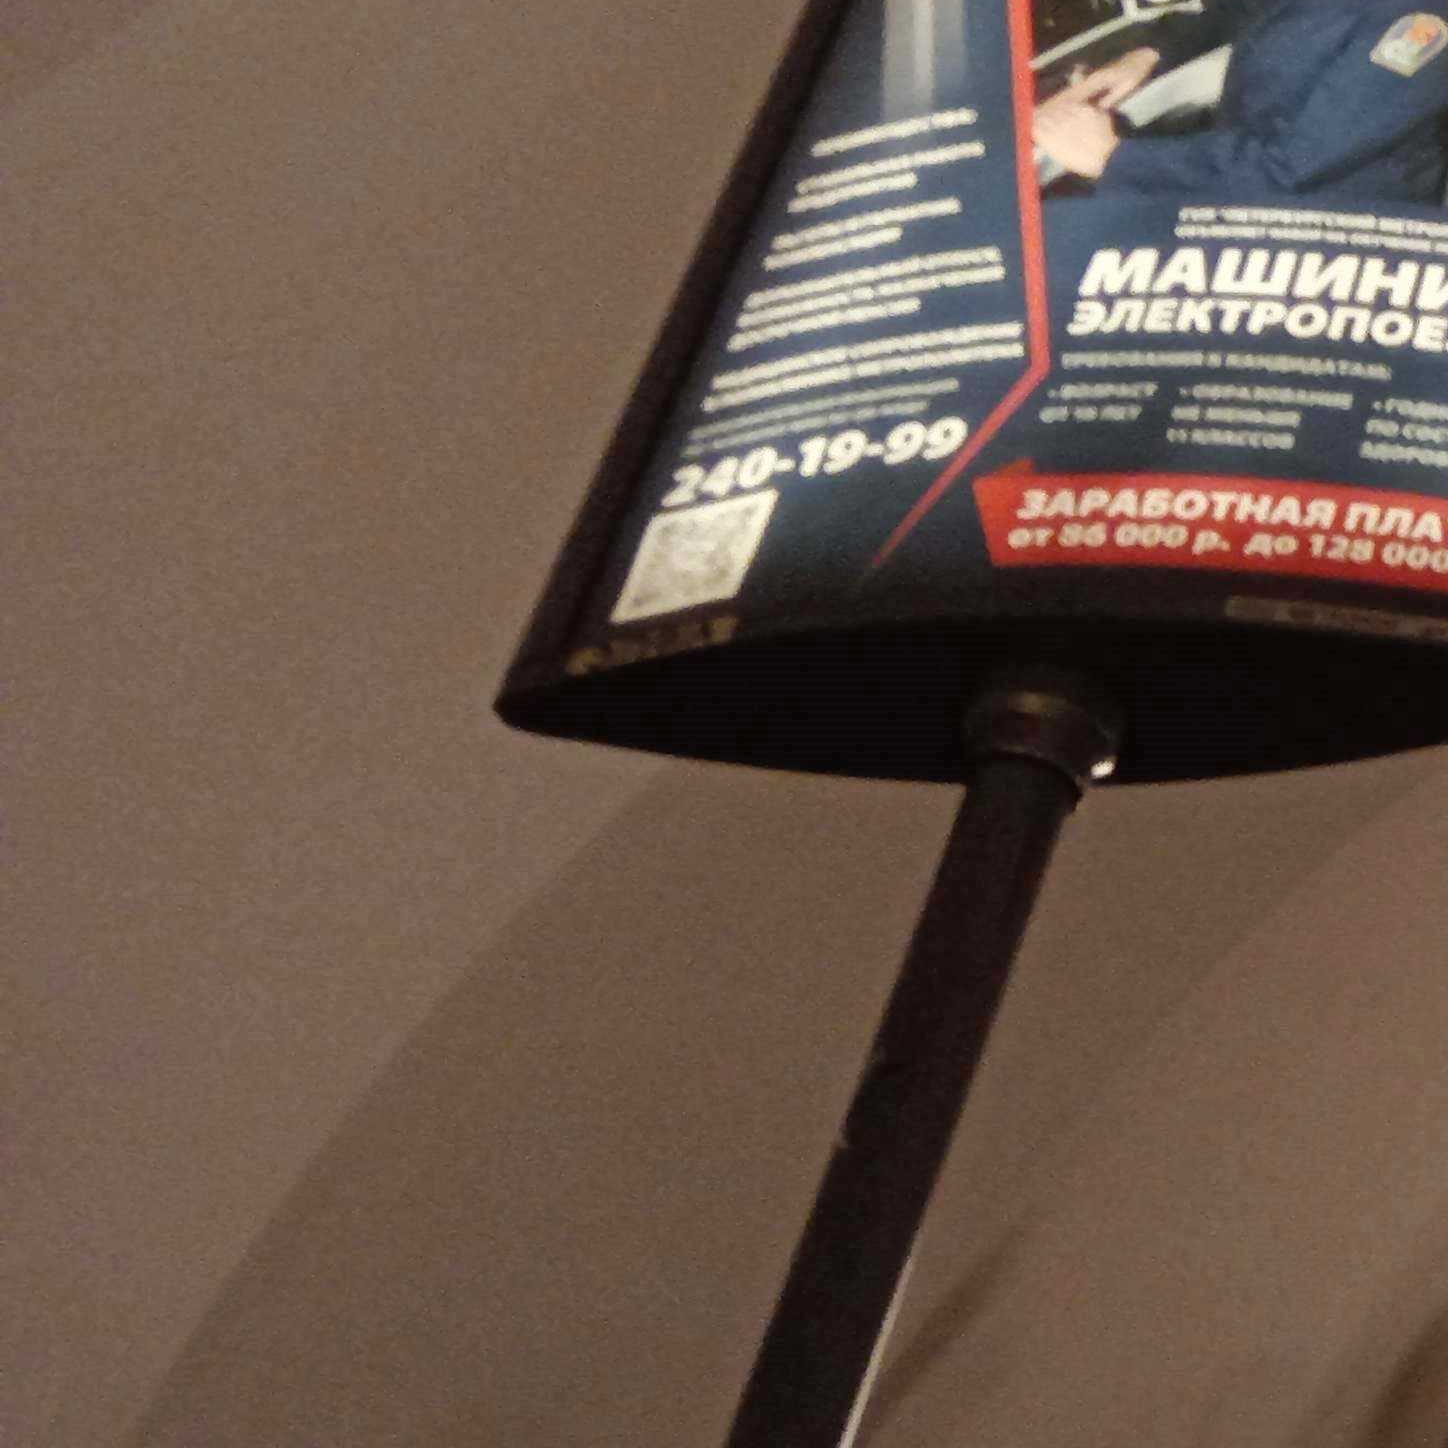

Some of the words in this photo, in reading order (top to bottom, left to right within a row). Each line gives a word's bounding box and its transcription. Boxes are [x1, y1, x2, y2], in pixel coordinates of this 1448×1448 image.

[661, 415, 968, 508] 240-19-99
[1015, 487, 1338, 531] ЗАРАБОТНАЯ
[1114, 522, 1189, 550] 000
[1244, 531, 1298, 560] до
